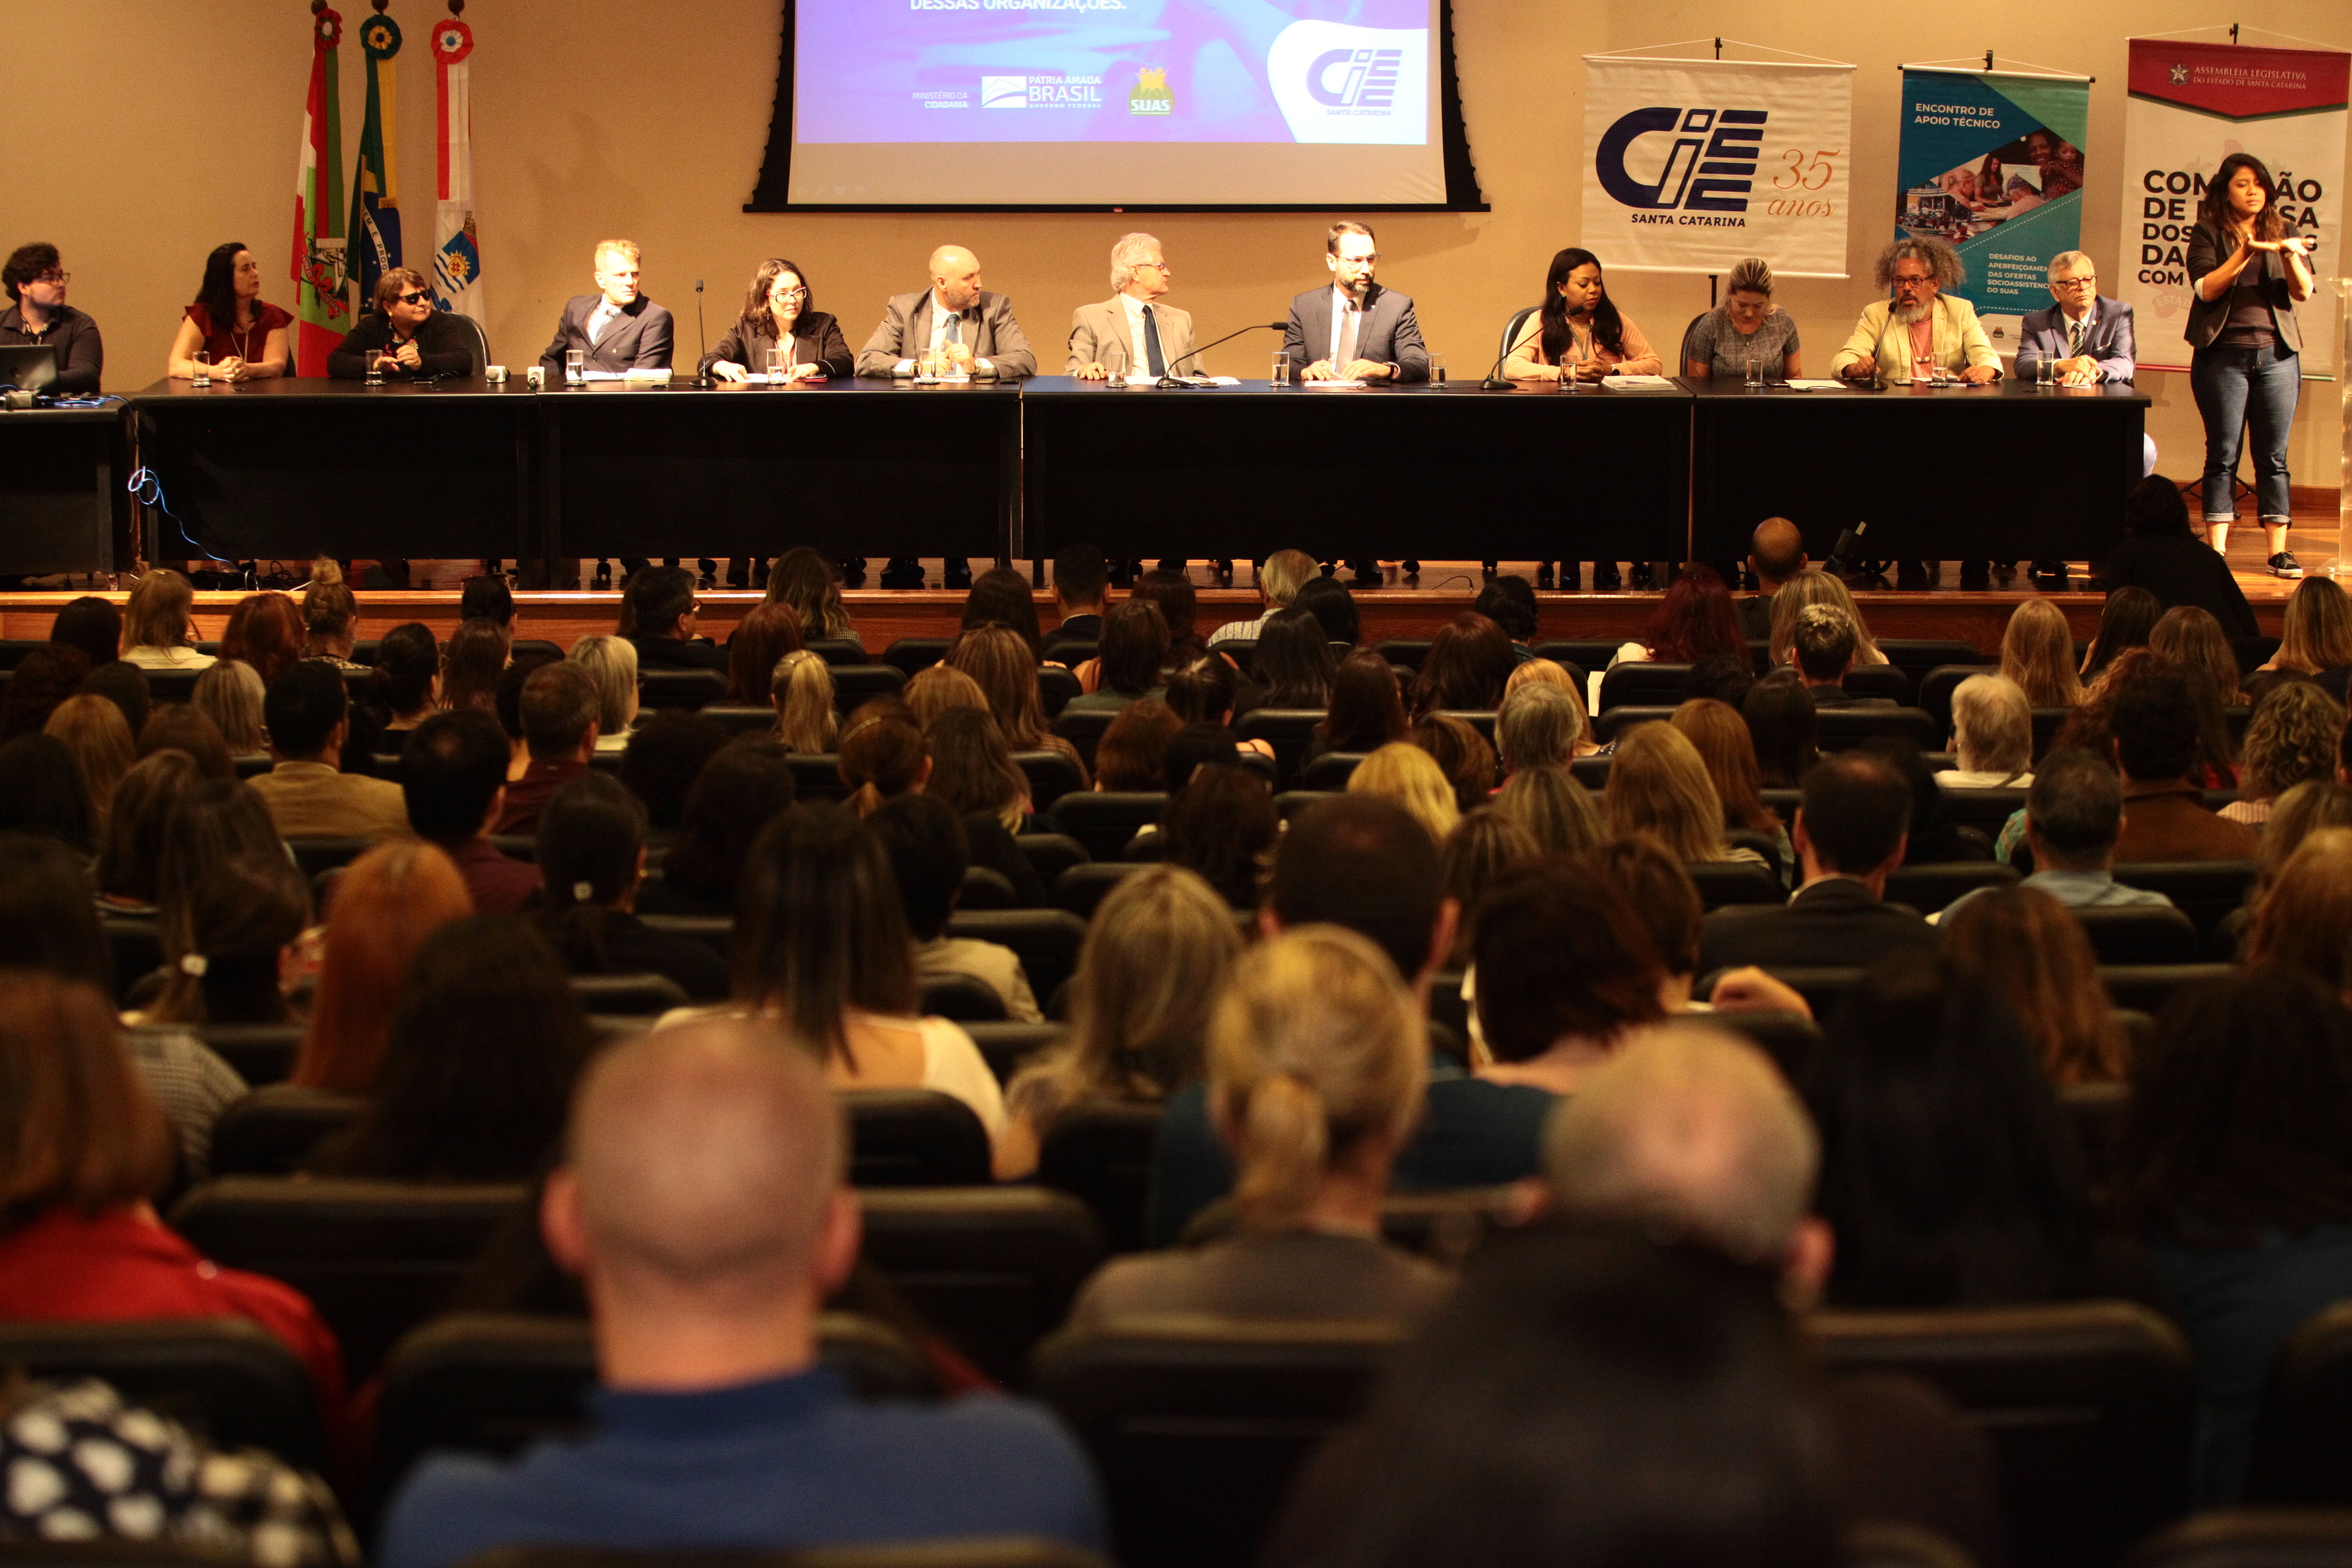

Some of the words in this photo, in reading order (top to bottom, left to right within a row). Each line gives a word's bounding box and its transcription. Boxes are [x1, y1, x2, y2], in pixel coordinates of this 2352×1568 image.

[910, 0, 980, 10] DESSAS
[1029, 74, 1063, 84] PÁTRIA
[1064, 76, 1101, 84] AMADA
[2194, 66, 2248, 77] ASSEMBLEIA
[2251, 69, 2306, 80] LEGISLATIVA
[2271, 81, 2306, 90] CATARINA
[912, 90, 956, 99] MINISTÉRIO
[1029, 85, 1102, 101] BRASIL
[1130, 99, 1171, 111] SUAS
[1915, 103, 1977, 115] ENCONTRO
[1979, 107, 1995, 116] DE
[1914, 116, 1951, 126] APOIO
[1952, 117, 2001, 128] TÉCNICO
[1772, 149, 1841, 190] 35
[1767, 198, 1837, 217] anos
[2143, 197, 2186, 220] DE
[1631, 214, 1674, 224] SANTA
[1679, 215, 1746, 227] CATARINA
[2142, 223, 2194, 242] DOS
[1988, 263, 2049, 272] APERFEIÇOAMEN
[2138, 270, 2184, 286] COM
